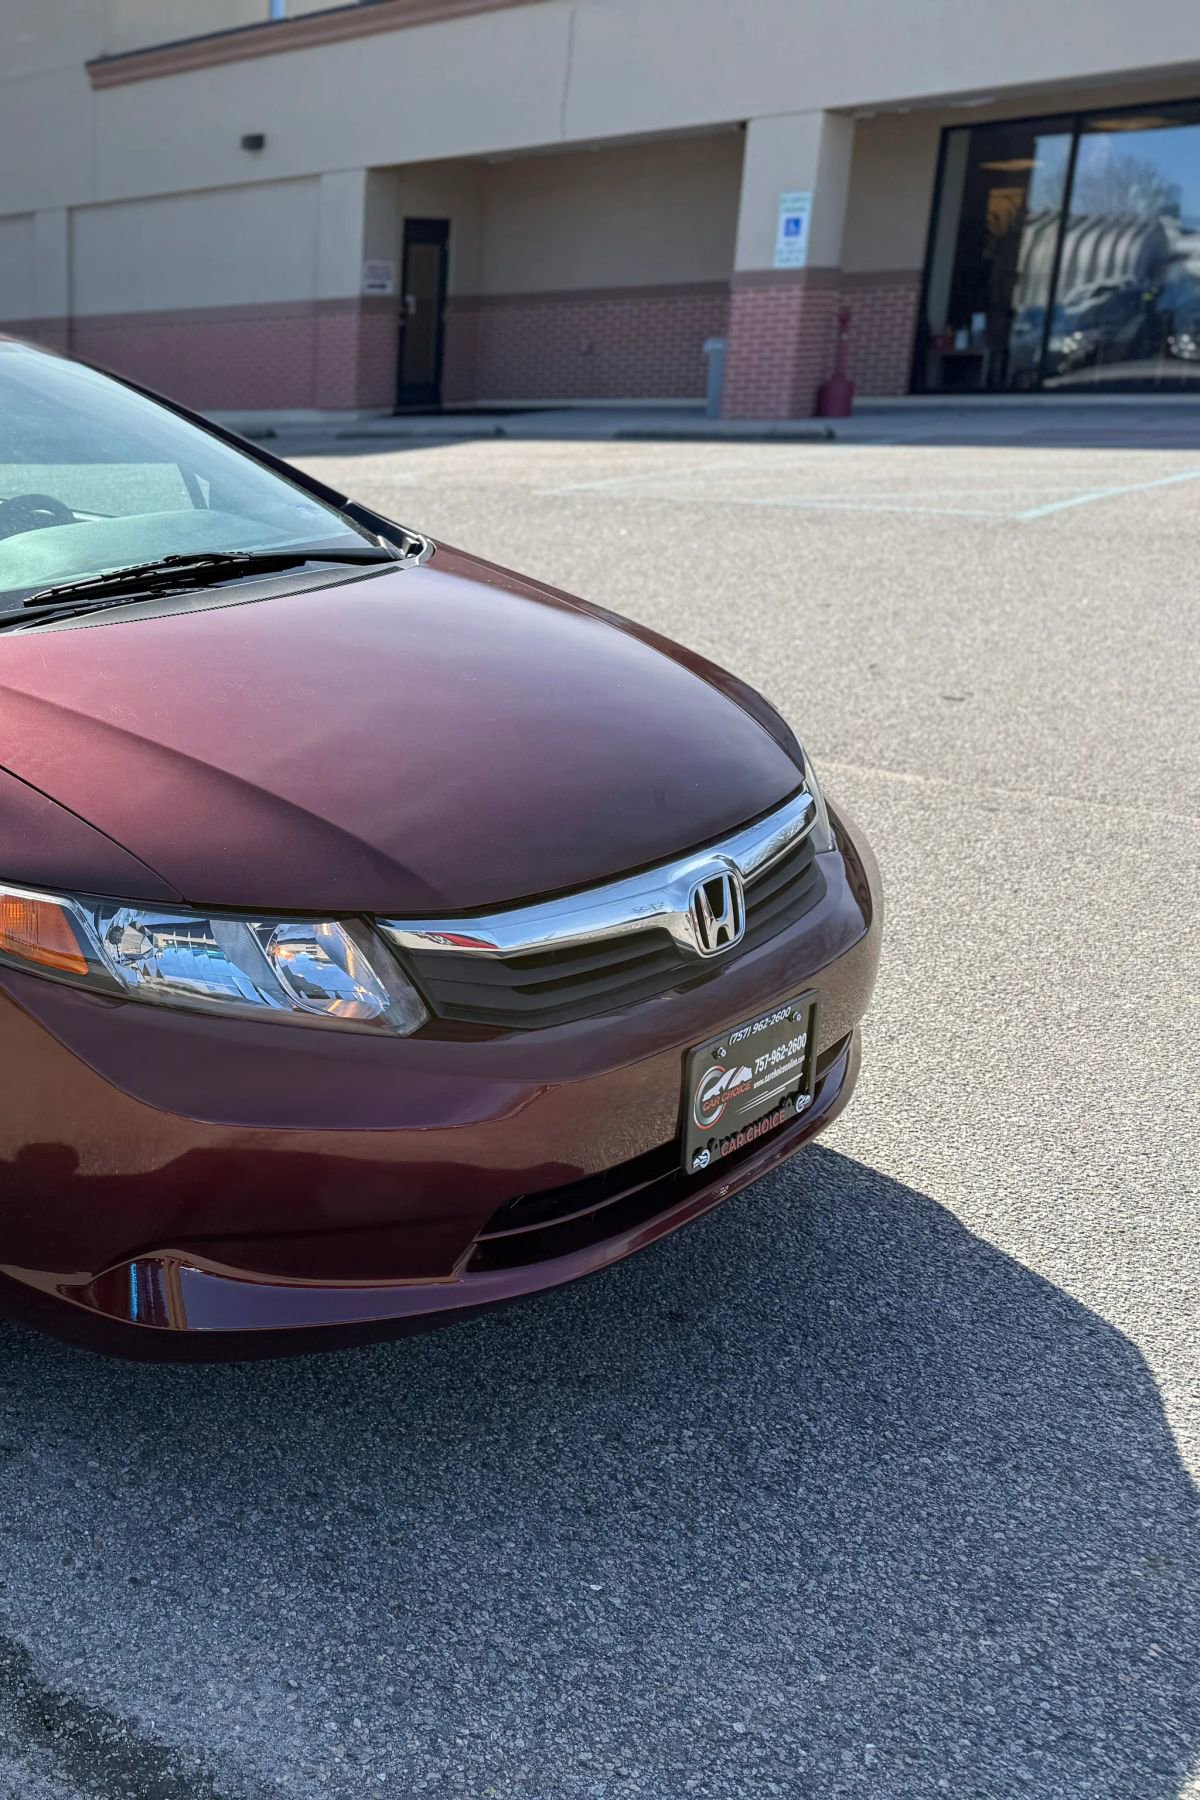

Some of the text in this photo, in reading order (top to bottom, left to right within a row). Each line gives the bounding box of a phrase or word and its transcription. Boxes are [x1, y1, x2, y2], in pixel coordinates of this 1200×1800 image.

[729, 1006, 791, 1046] (757) 962-2600
[754, 1032, 807, 1075] 757-962-2600
[703, 1081, 752, 1112] CAR CHOICE
[721, 1110, 785, 1157] CAR CHOICE
